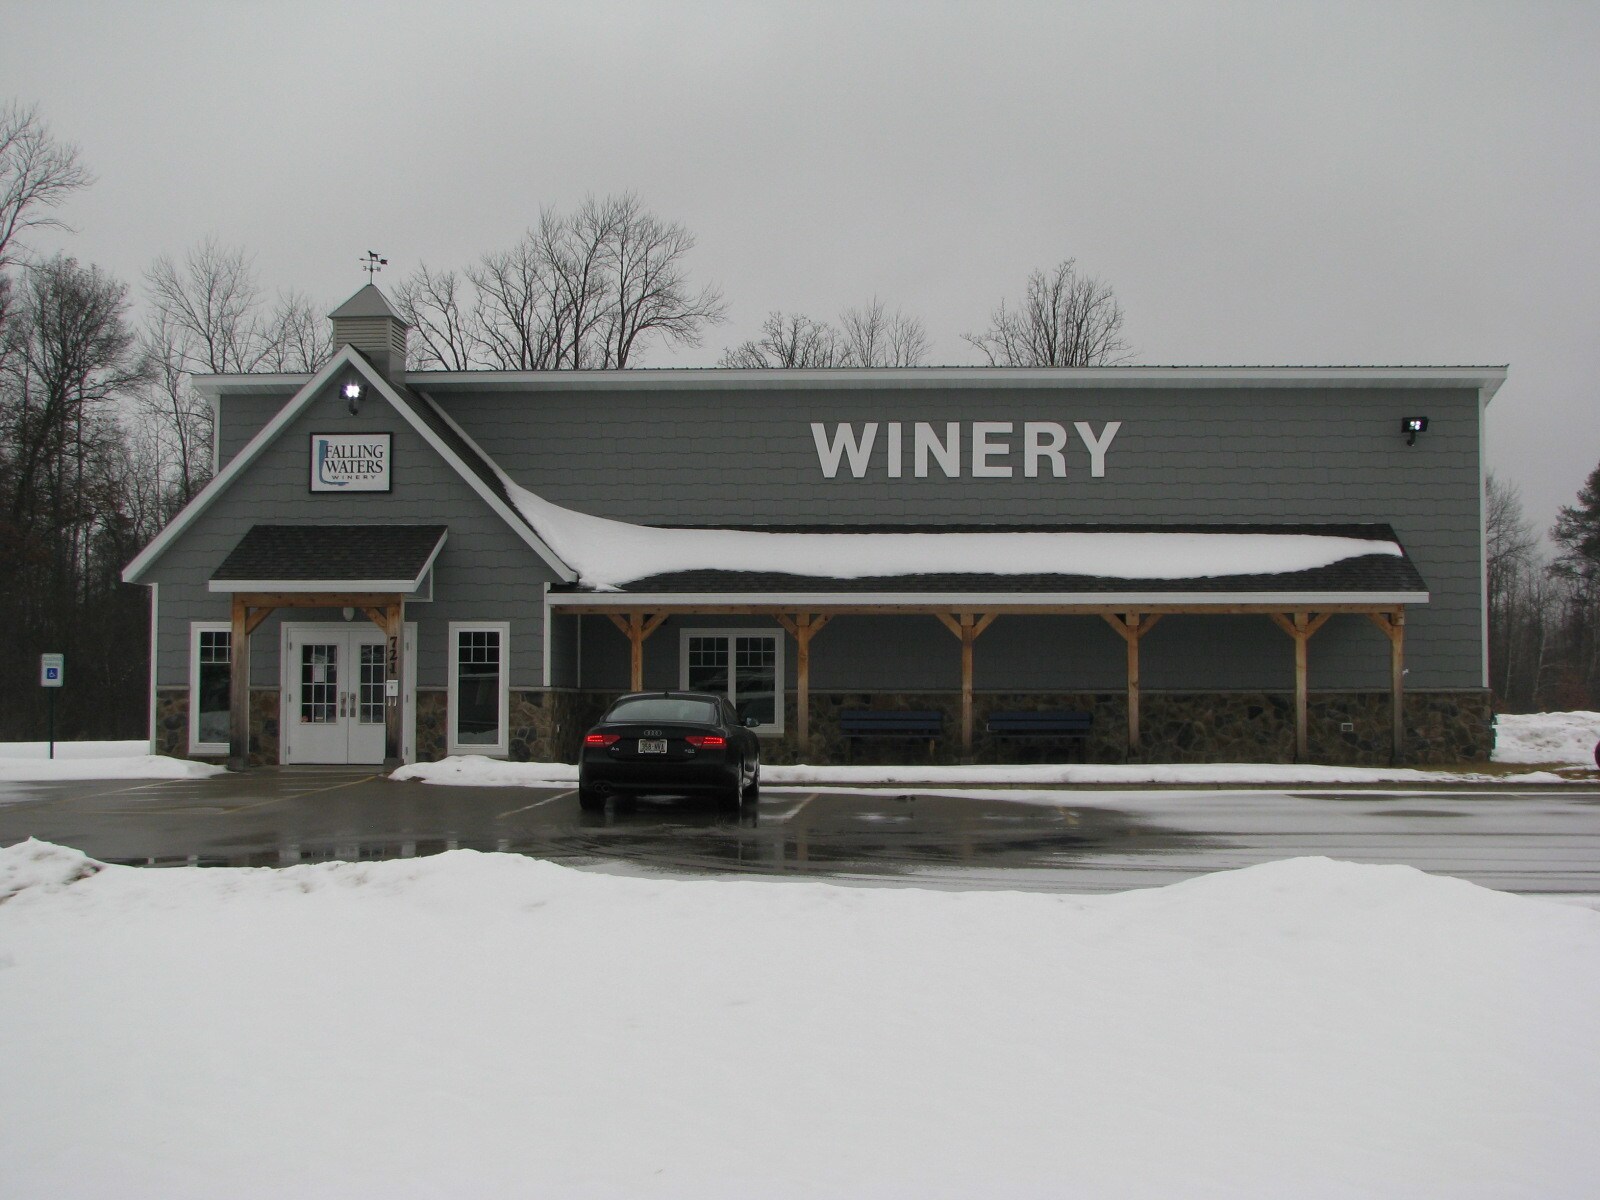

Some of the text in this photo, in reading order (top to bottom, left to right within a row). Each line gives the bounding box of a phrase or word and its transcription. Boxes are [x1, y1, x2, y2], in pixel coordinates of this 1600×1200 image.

[325, 444, 384, 459] FALLING
[810, 421, 1122, 478] WINERY
[325, 459, 383, 473] WATERS
[389, 636, 398, 673] 721
